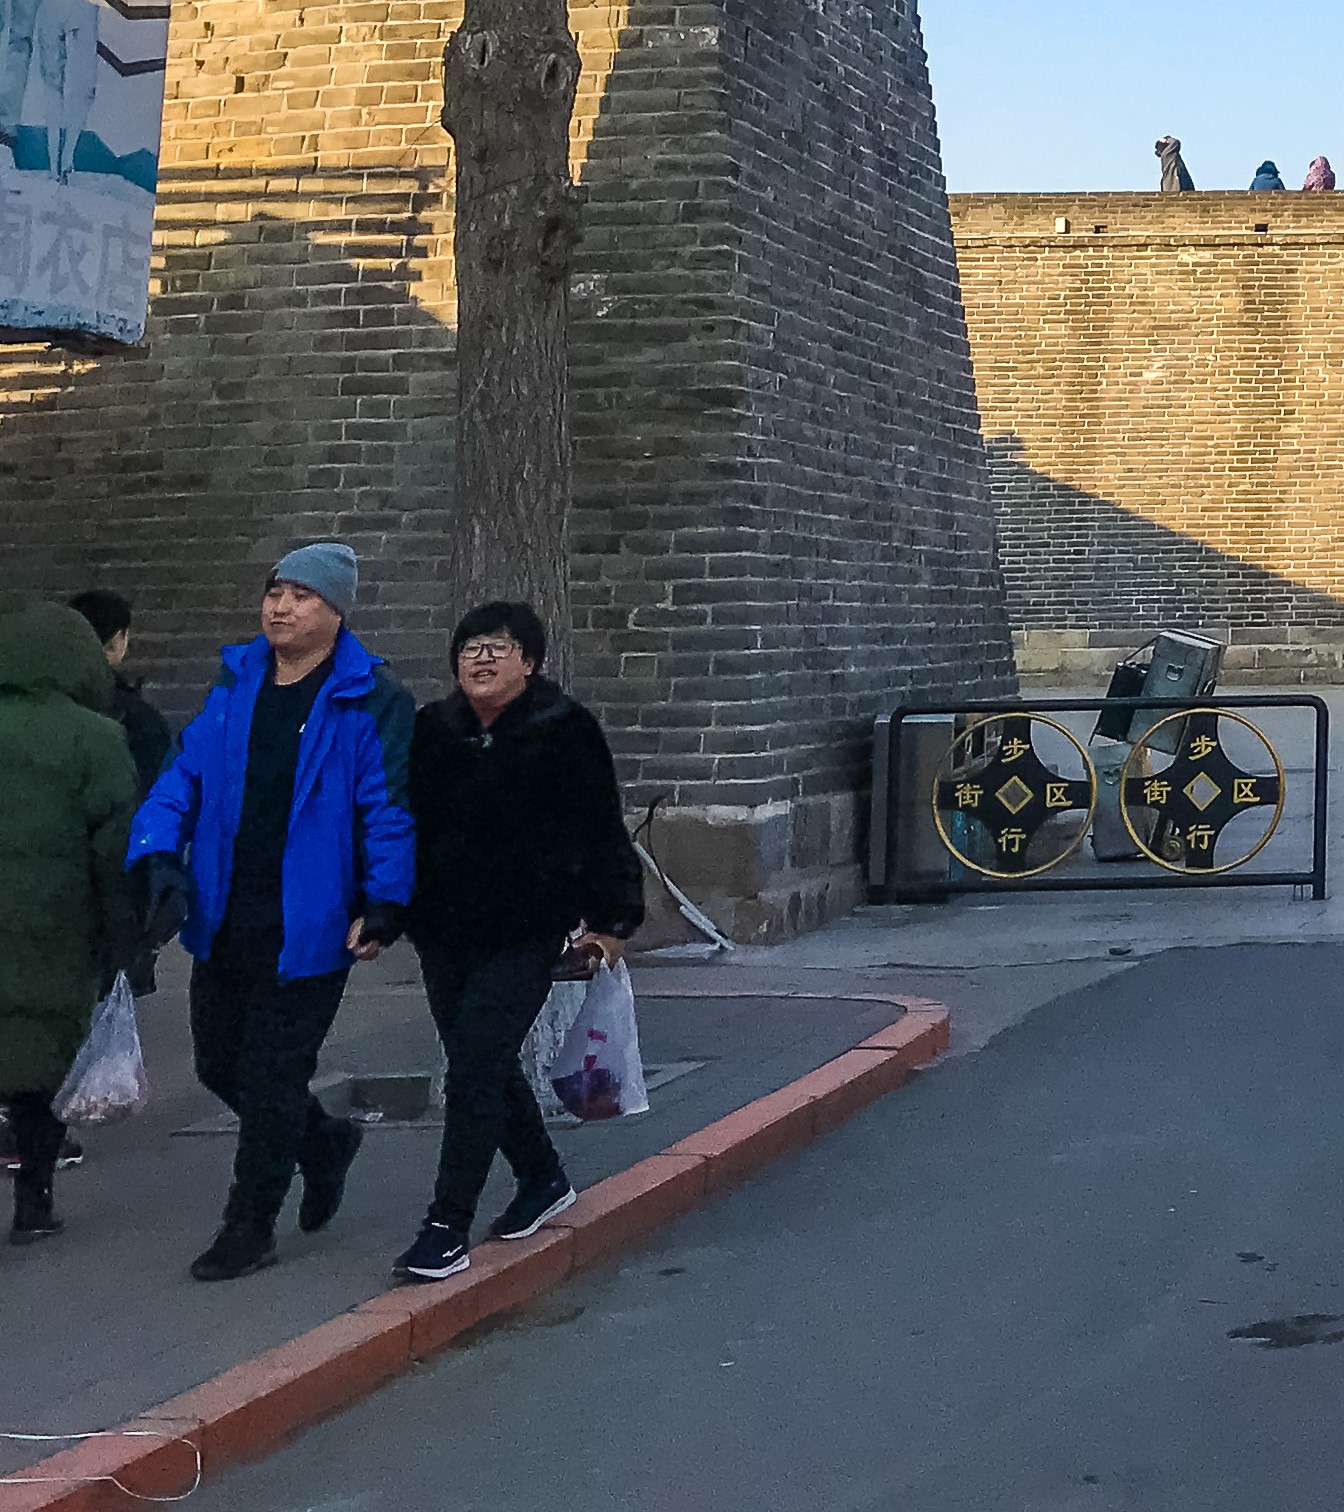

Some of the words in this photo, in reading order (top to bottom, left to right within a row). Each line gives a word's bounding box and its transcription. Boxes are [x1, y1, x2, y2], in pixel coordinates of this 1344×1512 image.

[1002, 737, 1029, 763] 步
[1189, 734, 1217, 761] 步
[955, 783, 983, 808] 街
[1045, 782, 1072, 808] 区
[1143, 780, 1172, 805] 街
[1232, 778, 1261, 804] 区
[998, 827, 1026, 853] 行
[1186, 824, 1215, 850] 行
